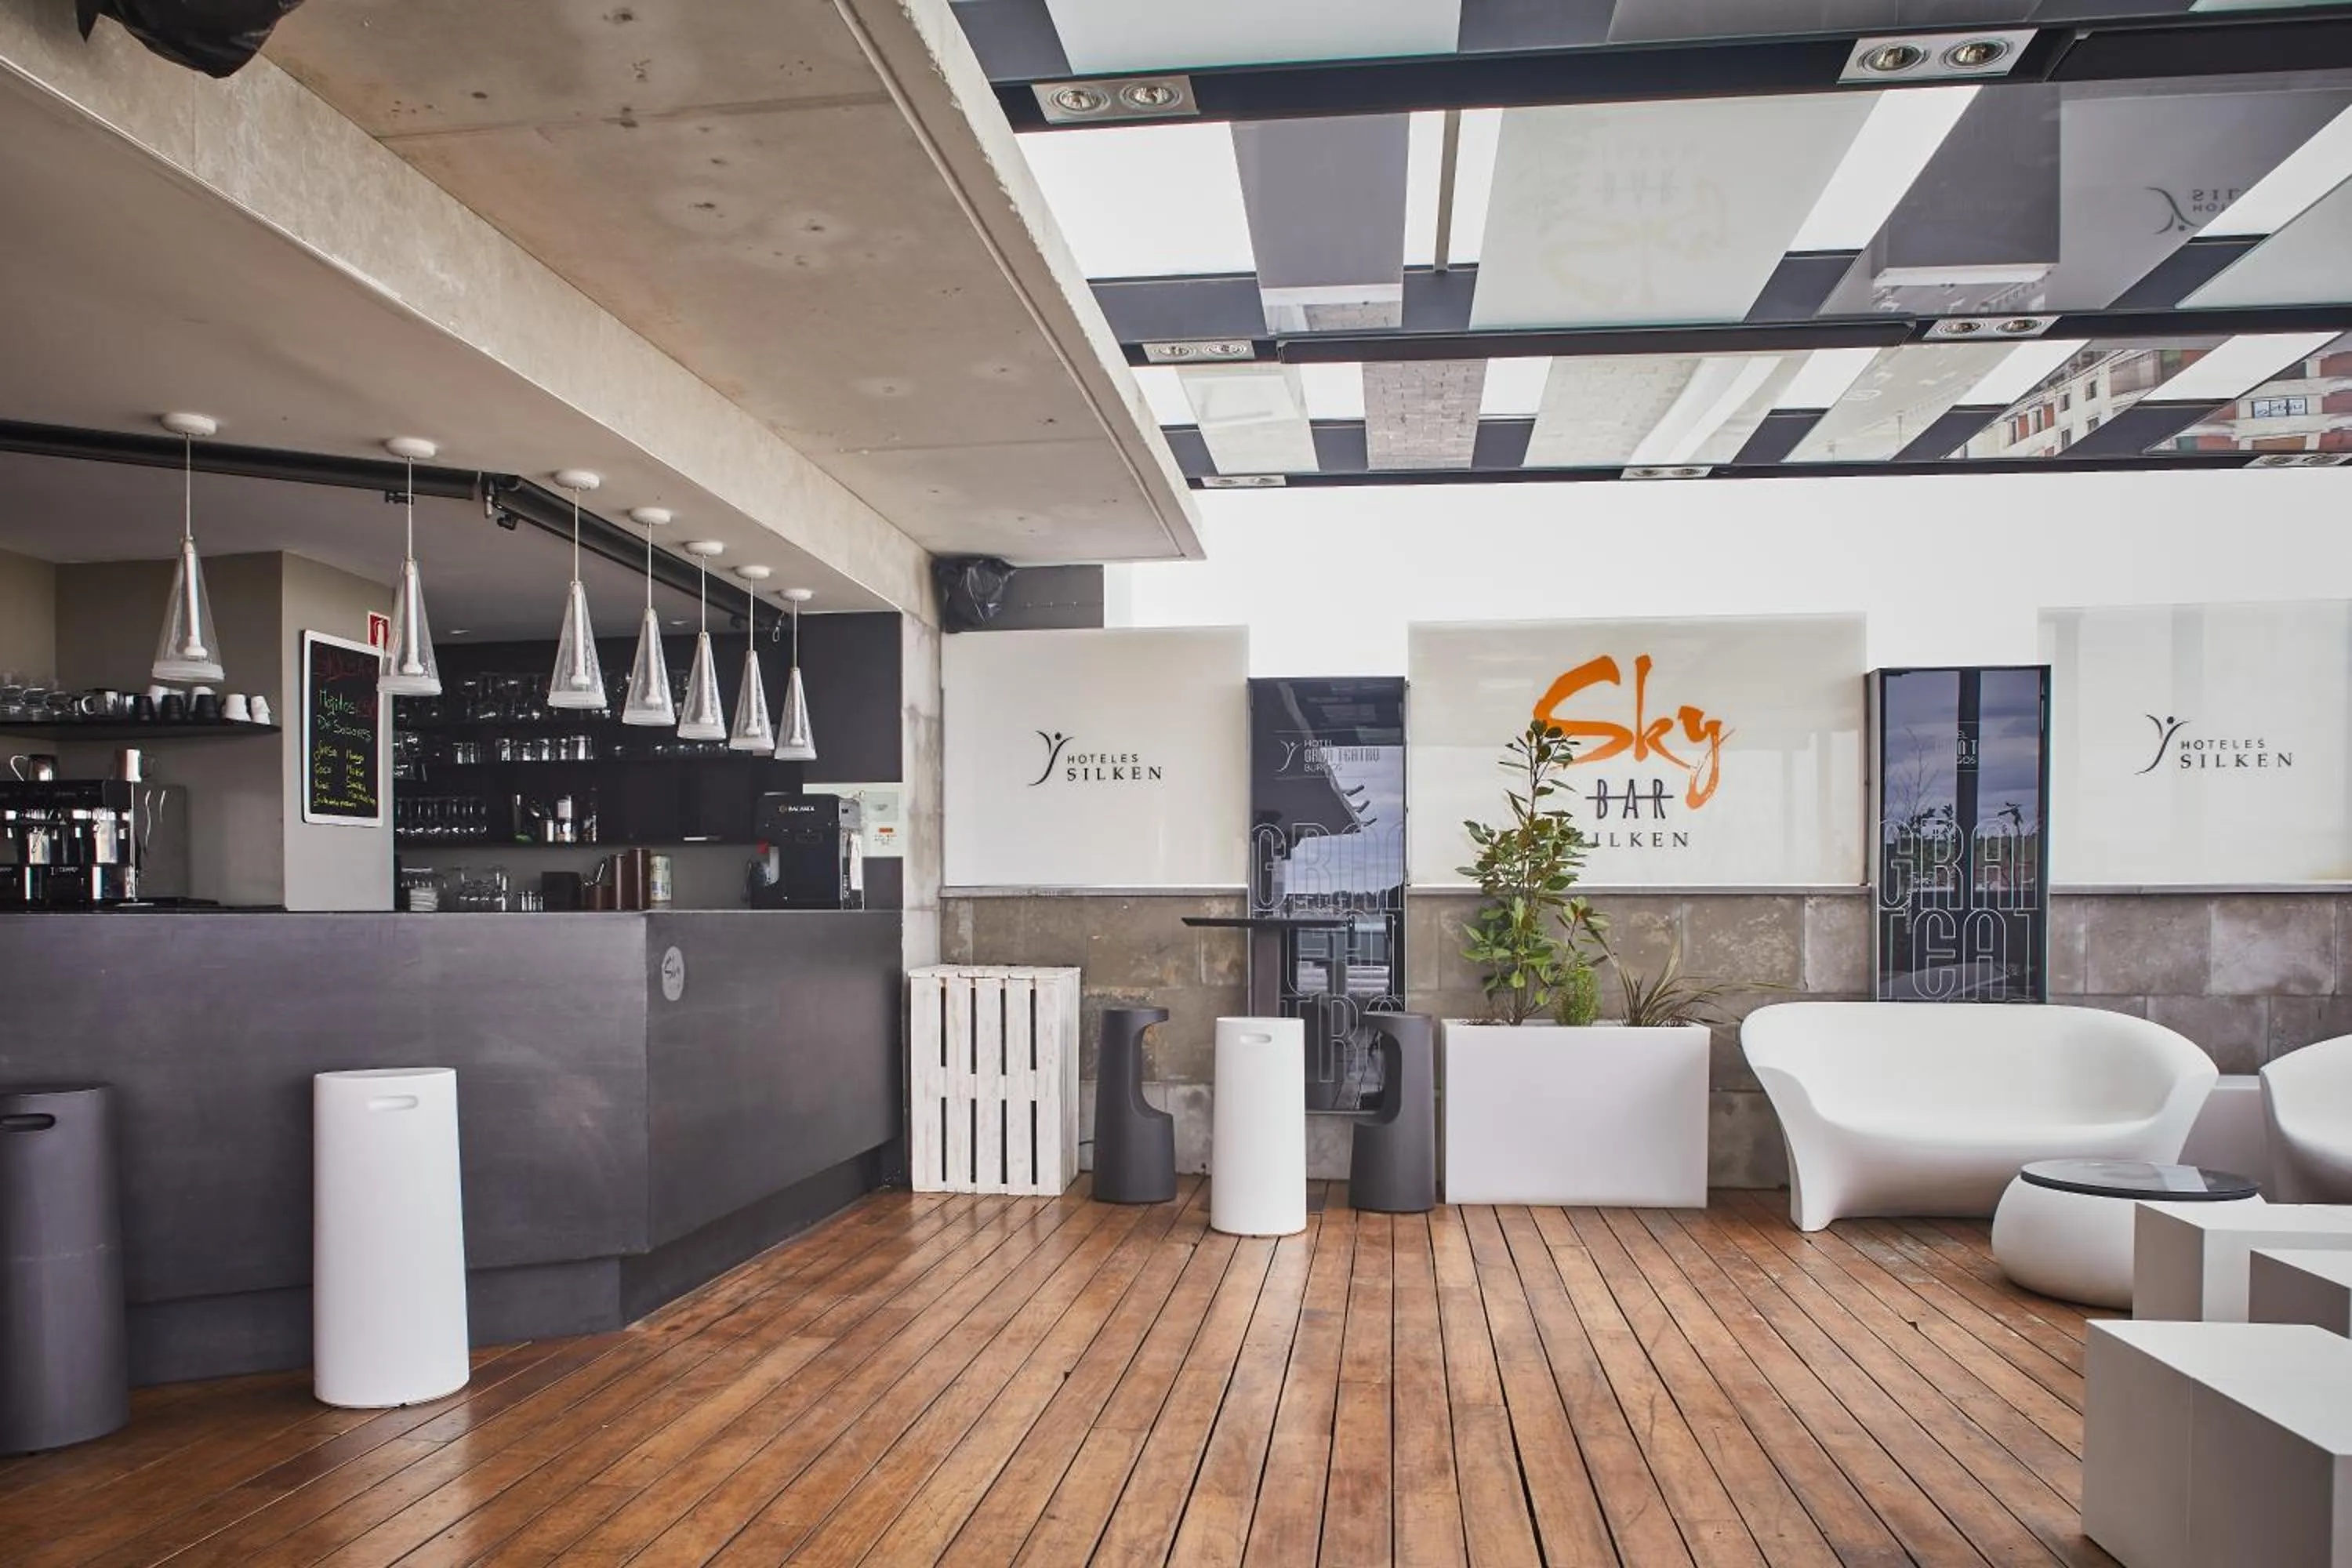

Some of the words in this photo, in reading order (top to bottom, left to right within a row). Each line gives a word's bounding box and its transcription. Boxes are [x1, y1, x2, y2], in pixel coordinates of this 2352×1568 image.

[1533, 654, 1734, 809] Sky
[2180, 739, 2266, 750] HOTELES
[1067, 753, 1139, 764] HOTELES
[2180, 753, 2293, 769] SILKEN
[1067, 766, 1163, 782] SILKEN
[1595, 779, 1667, 820] BAR
[1591, 832, 1690, 848] ILKEN
